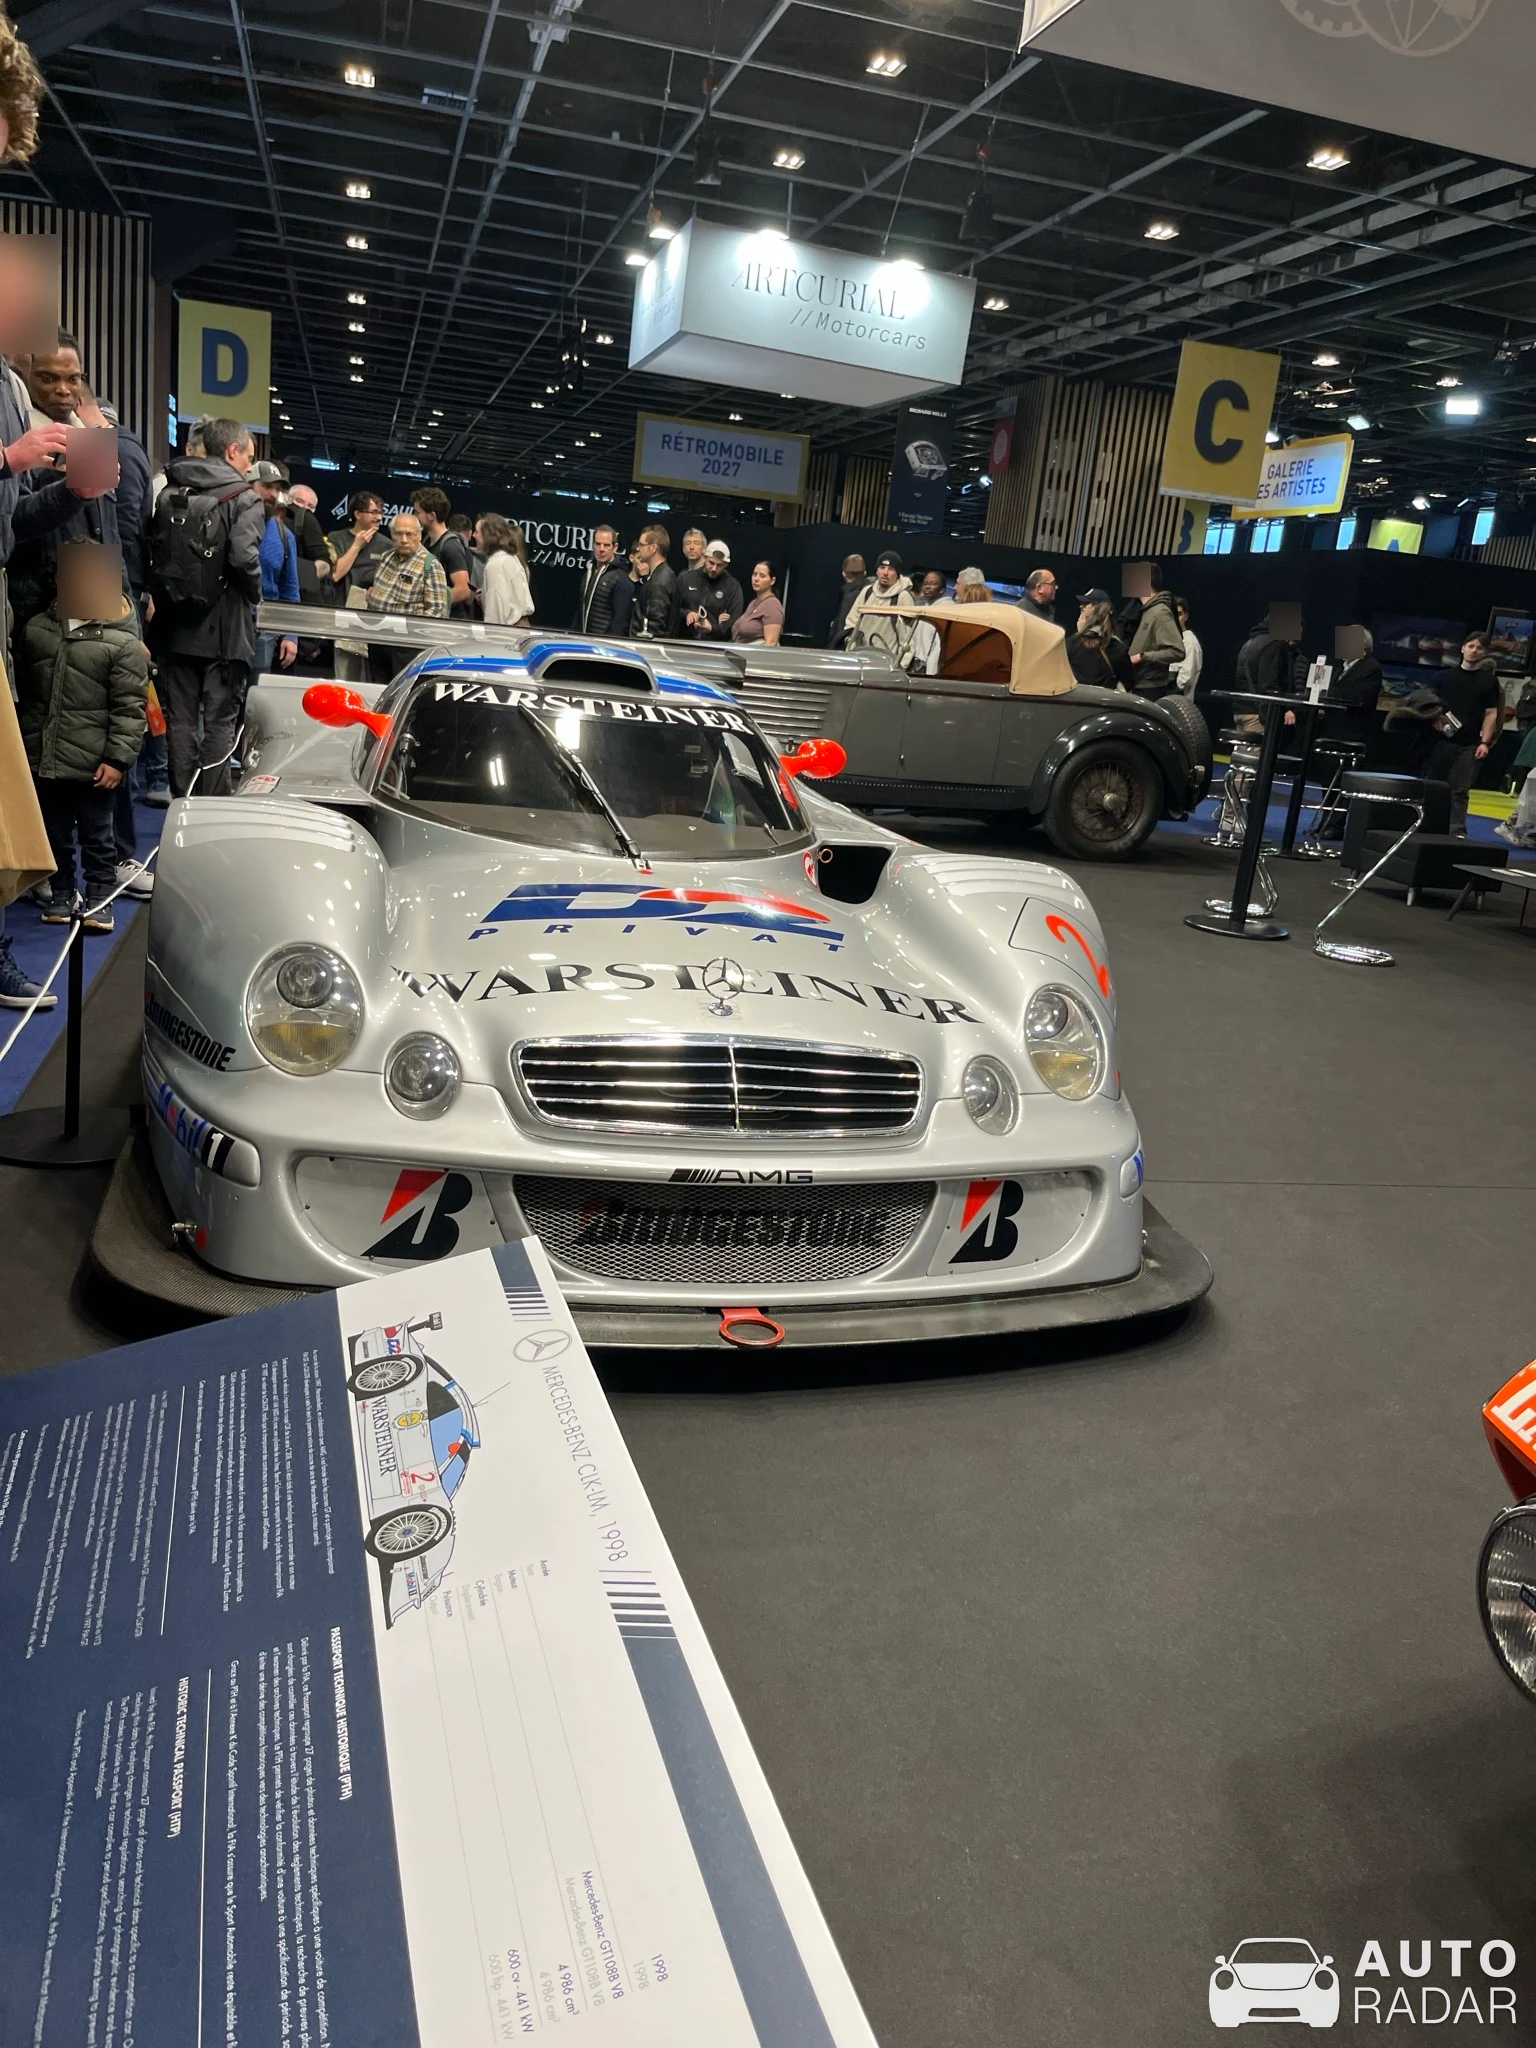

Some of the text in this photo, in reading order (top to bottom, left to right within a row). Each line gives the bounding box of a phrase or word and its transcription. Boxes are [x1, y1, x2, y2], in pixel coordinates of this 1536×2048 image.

[731, 262, 906, 320] ARTCURIAL
[202, 327, 248, 397] D
[1194, 380, 1249, 465] C
[661, 430, 784, 466] RÉTROMOBILE
[702, 458, 740, 478] 2027
[1267, 458, 1315, 480] GALERIE
[1256, 477, 1326, 499] ES ARTISTES
[433, 682, 754, 735] WARSTEINER
[467, 924, 845, 952] PRIVAT
[389, 963, 985, 1025] WARSTEINER
[159, 1082, 208, 1153] Mobil
[714, 1169, 814, 1184] AMG
[570, 1199, 887, 1248] BRIDGESTONE
[371, 1396, 397, 1476] WARSTEINER
[543, 1365, 628, 1561] MERCEDES-BENZ CLK-LM, 1998
[411, 1472, 436, 1484] 2
[406, 1571, 417, 1590] Mobil
[442, 1590, 453, 1618] Puissance
[474, 1580, 488, 1606] Cylindrée
[299, 1655, 307, 1665] par
[301, 1664, 310, 1672] la
[273, 1676, 281, 1687] des
[287, 1677, 296, 1685] de
[301, 1671, 310, 1684] FIA,
[331, 1626, 352, 1800] PASSEPORT TECHNIQUE HISTORIQUE (PTH)
[289, 1721, 297, 1746] données
[167, 1676, 188, 1837] HISTORIC TECHNICAL PASSPORT (HTP)
[274, 1742, 282, 1750] Le
[274, 1750, 283, 1763] PTH
[304, 1745, 314, 1754] 27
[303, 1756, 312, 1776] pages
[290, 1772, 299, 1795] l'étude
[306, 1776, 315, 1785] de
[274, 1789, 284, 1798] de
[291, 1795, 300, 1805] de
[304, 1786, 315, 1808] photos
[275, 1821, 285, 1830] la
[291, 1804, 300, 1839] l'évolution
[307, 1816, 317, 1845] données
[275, 1831, 285, 1866] conformité
[292, 1840, 301, 1853] des
[290, 1854, 302, 1891] règlements
[308, 1845, 318, 1883] techniques
[276, 1867, 286, 1888] d'une
[277, 1889, 285, 1914] voiture
[309, 1884, 322, 1924] spécifiques
[293, 1892, 304, 1934] techniques,
[296, 1934, 306, 1944] la
[313, 1933, 321, 1948] une
[564, 1877, 605, 2007] Mercedes-Benz GT108B V8
[581, 1871, 624, 1999] Mercedes-Benz GT108B V8
[276, 1939, 289, 1987] spécification
[296, 1945, 307, 1984] recherche
[315, 1949, 323, 1976] voiture
[488, 1954, 502, 1975] 600
[507, 1949, 521, 1969] 600
[651, 1954, 669, 1982] 1998
[316, 1978, 326, 1989] de
[490, 1976, 504, 1990] hp
[512, 1972, 521, 1983] cv
[539, 1971, 550, 1979] 4
[560, 1973, 574, 1995] 986
[633, 1961, 650, 1989] 1998
[280, 1988, 291, 2000] de
[298, 1985, 309, 1996] de
[515, 1992, 529, 2011] 441
[541, 1980, 556, 2002] 986
[296, 1998, 307, 2031] preuves
[316, 1991, 328, 2040] compétition.
[496, 1999, 510, 2018] 441
[564, 1997, 580, 2016] cm³
[278, 2001, 292, 2037] période,
[520, 2013, 534, 2033] kW
[500, 2021, 515, 2040] kW
